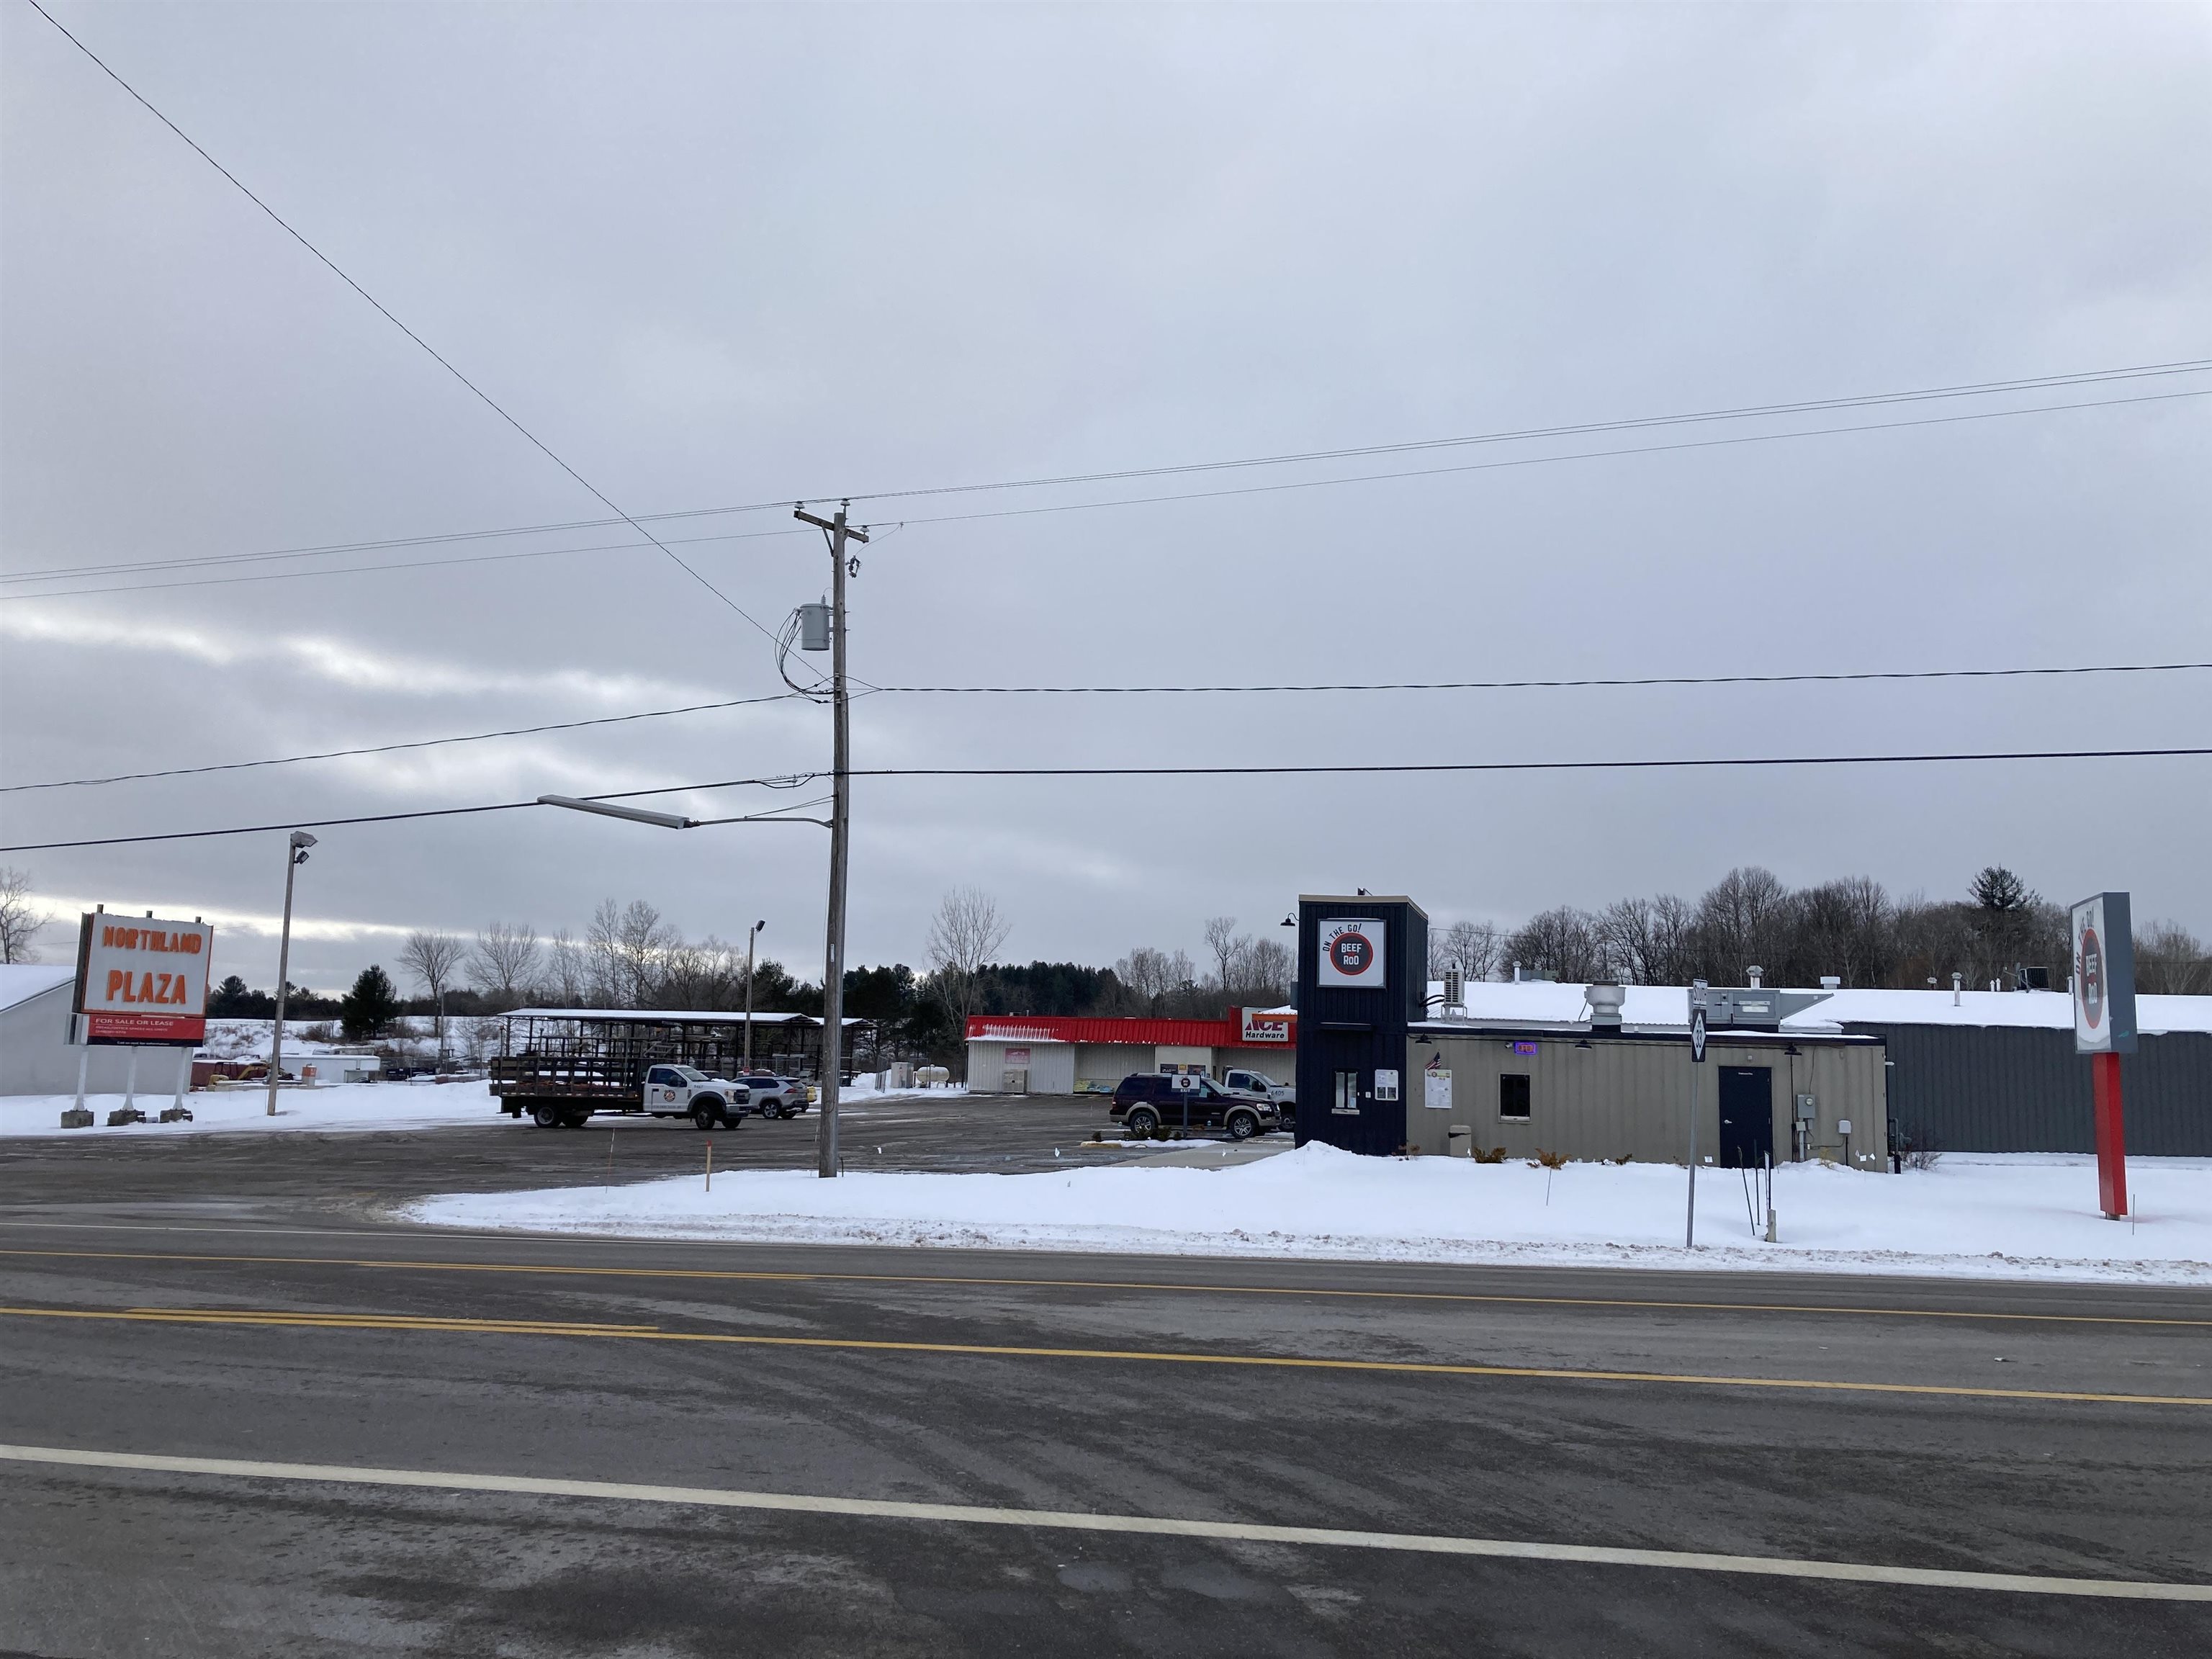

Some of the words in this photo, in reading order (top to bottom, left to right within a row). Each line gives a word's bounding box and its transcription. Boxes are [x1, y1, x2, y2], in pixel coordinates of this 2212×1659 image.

[104, 926, 202, 954] NORTHLAND
[1322, 940, 1332, 952] ON
[1328, 926, 1344, 940] THE
[1347, 923, 1362, 933] GO!
[1341, 943, 1362, 953] BEEF
[107, 970, 186, 1004] PLAZA
[1244, 1019, 1284, 1031] ACE
[1695, 1029, 1702, 1048] 33
